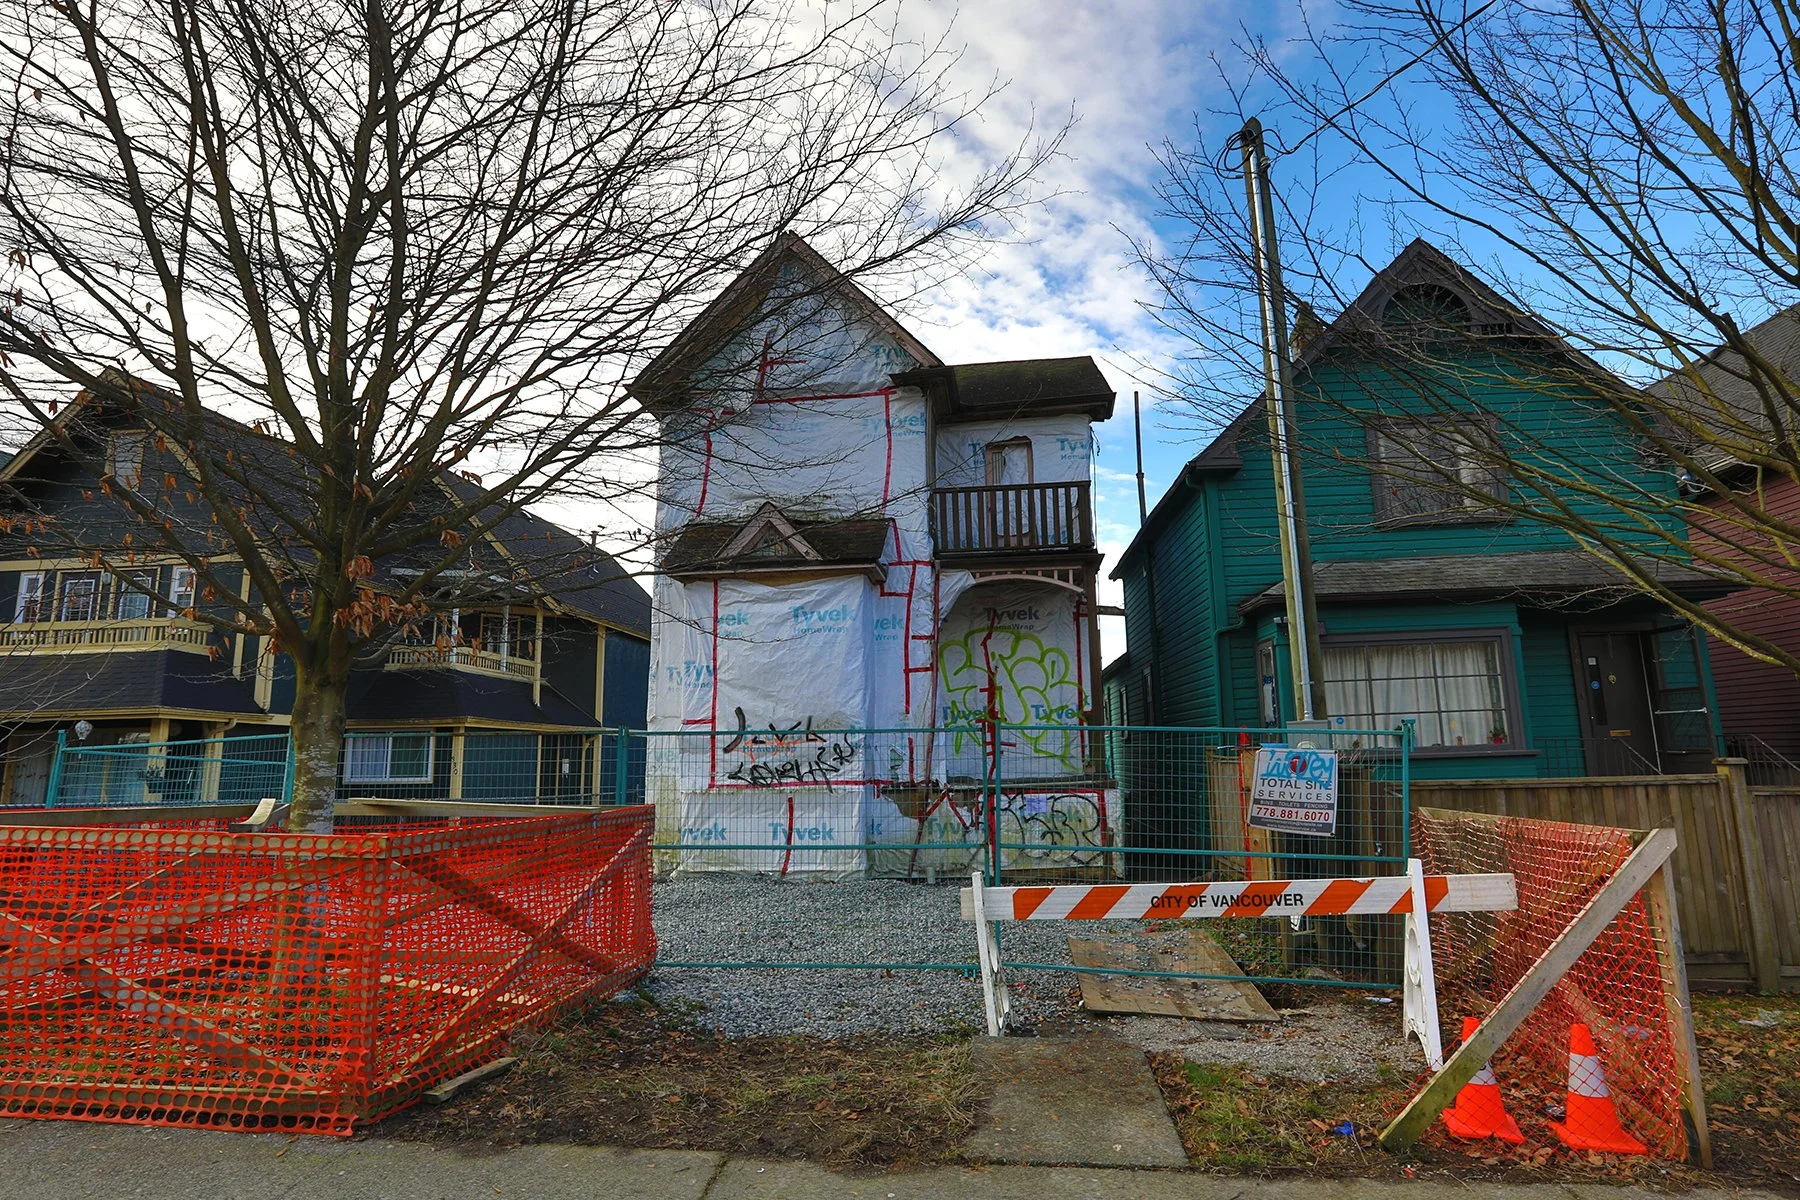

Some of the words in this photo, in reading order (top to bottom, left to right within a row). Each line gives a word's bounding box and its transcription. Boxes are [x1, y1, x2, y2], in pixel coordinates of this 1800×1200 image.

[788, 604, 856, 625] Tyvek
[983, 605, 1040, 625] Tyvek
[793, 625, 848, 634] HomeWrap
[1260, 777, 1301, 790] TOTAL
[1258, 789, 1332, 801] SERVICES
[1256, 806, 1330, 822] 778.881.6070
[768, 822, 836, 842] Tyvek
[1150, 895, 1183, 909] CITY
[1187, 895, 1207, 908] OF
[1211, 893, 1304, 908] VANCOUVER
